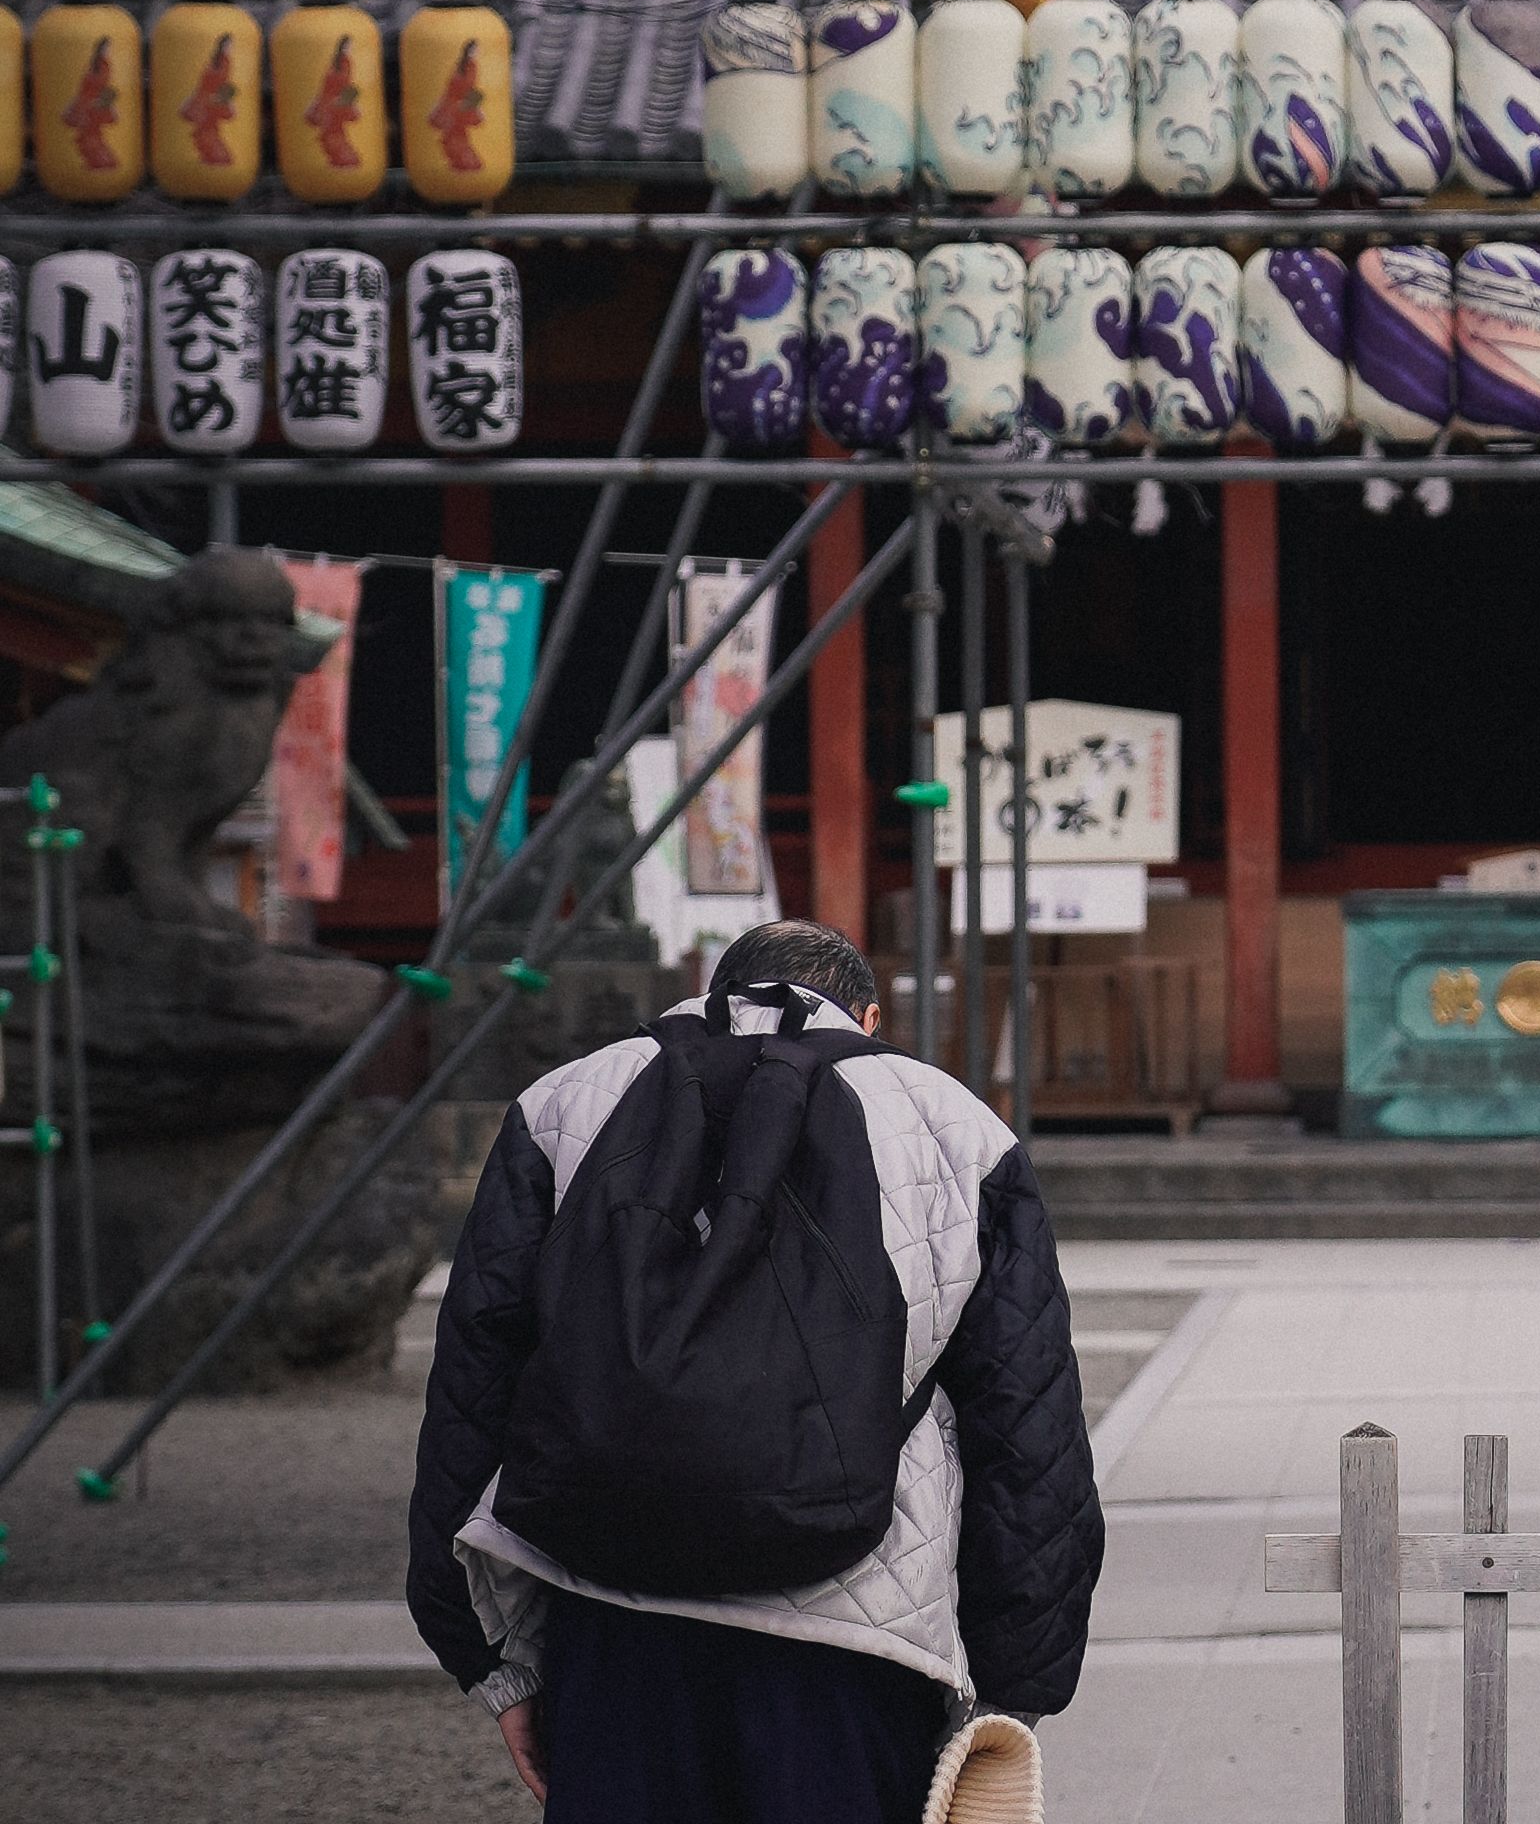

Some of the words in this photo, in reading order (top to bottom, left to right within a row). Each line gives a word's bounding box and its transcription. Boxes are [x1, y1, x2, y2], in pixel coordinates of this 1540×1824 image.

[33, 285, 120, 383] 山
[161, 255, 240, 433] 笑ひめ
[412, 263, 503, 439] 福家
